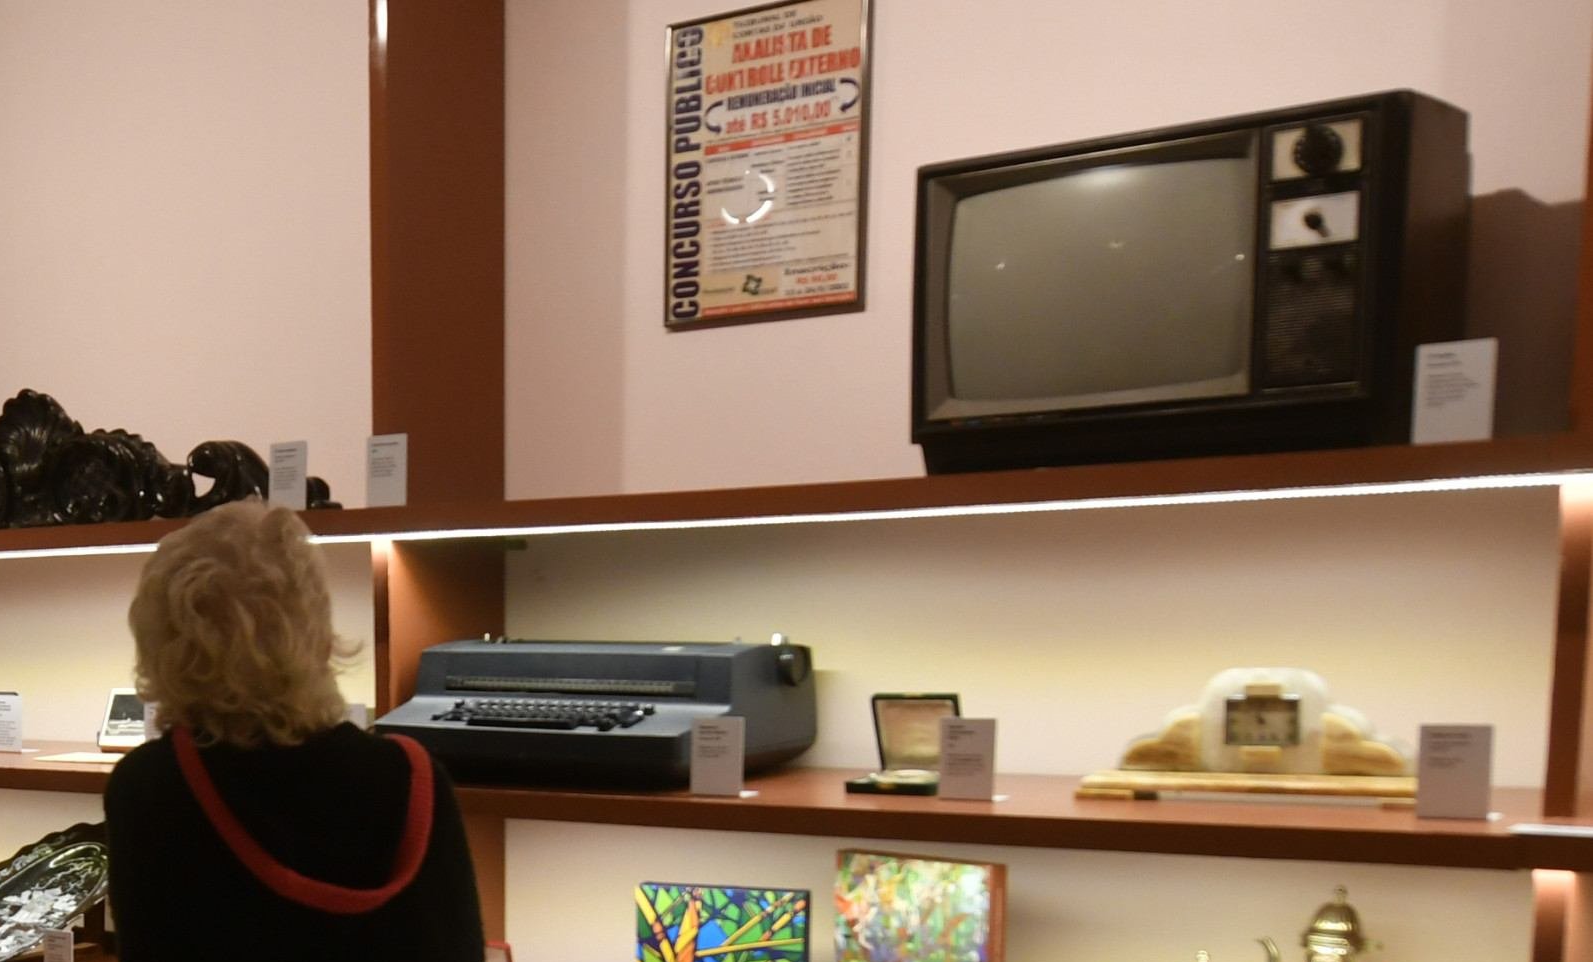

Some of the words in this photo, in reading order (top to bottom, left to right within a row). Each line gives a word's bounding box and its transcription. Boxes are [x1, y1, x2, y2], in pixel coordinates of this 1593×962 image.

[732, 29, 807, 64] ANALISTA
[811, 24, 832, 48] DE
[705, 61, 785, 95] CONTROLE
[788, 46, 860, 79] EXTERNO
[727, 83, 797, 111] REMUNERAÇÃO
[800, 78, 836, 98] INICIAL
[751, 110, 767, 129] R$
[672, 160, 701, 319] CONCURSO
